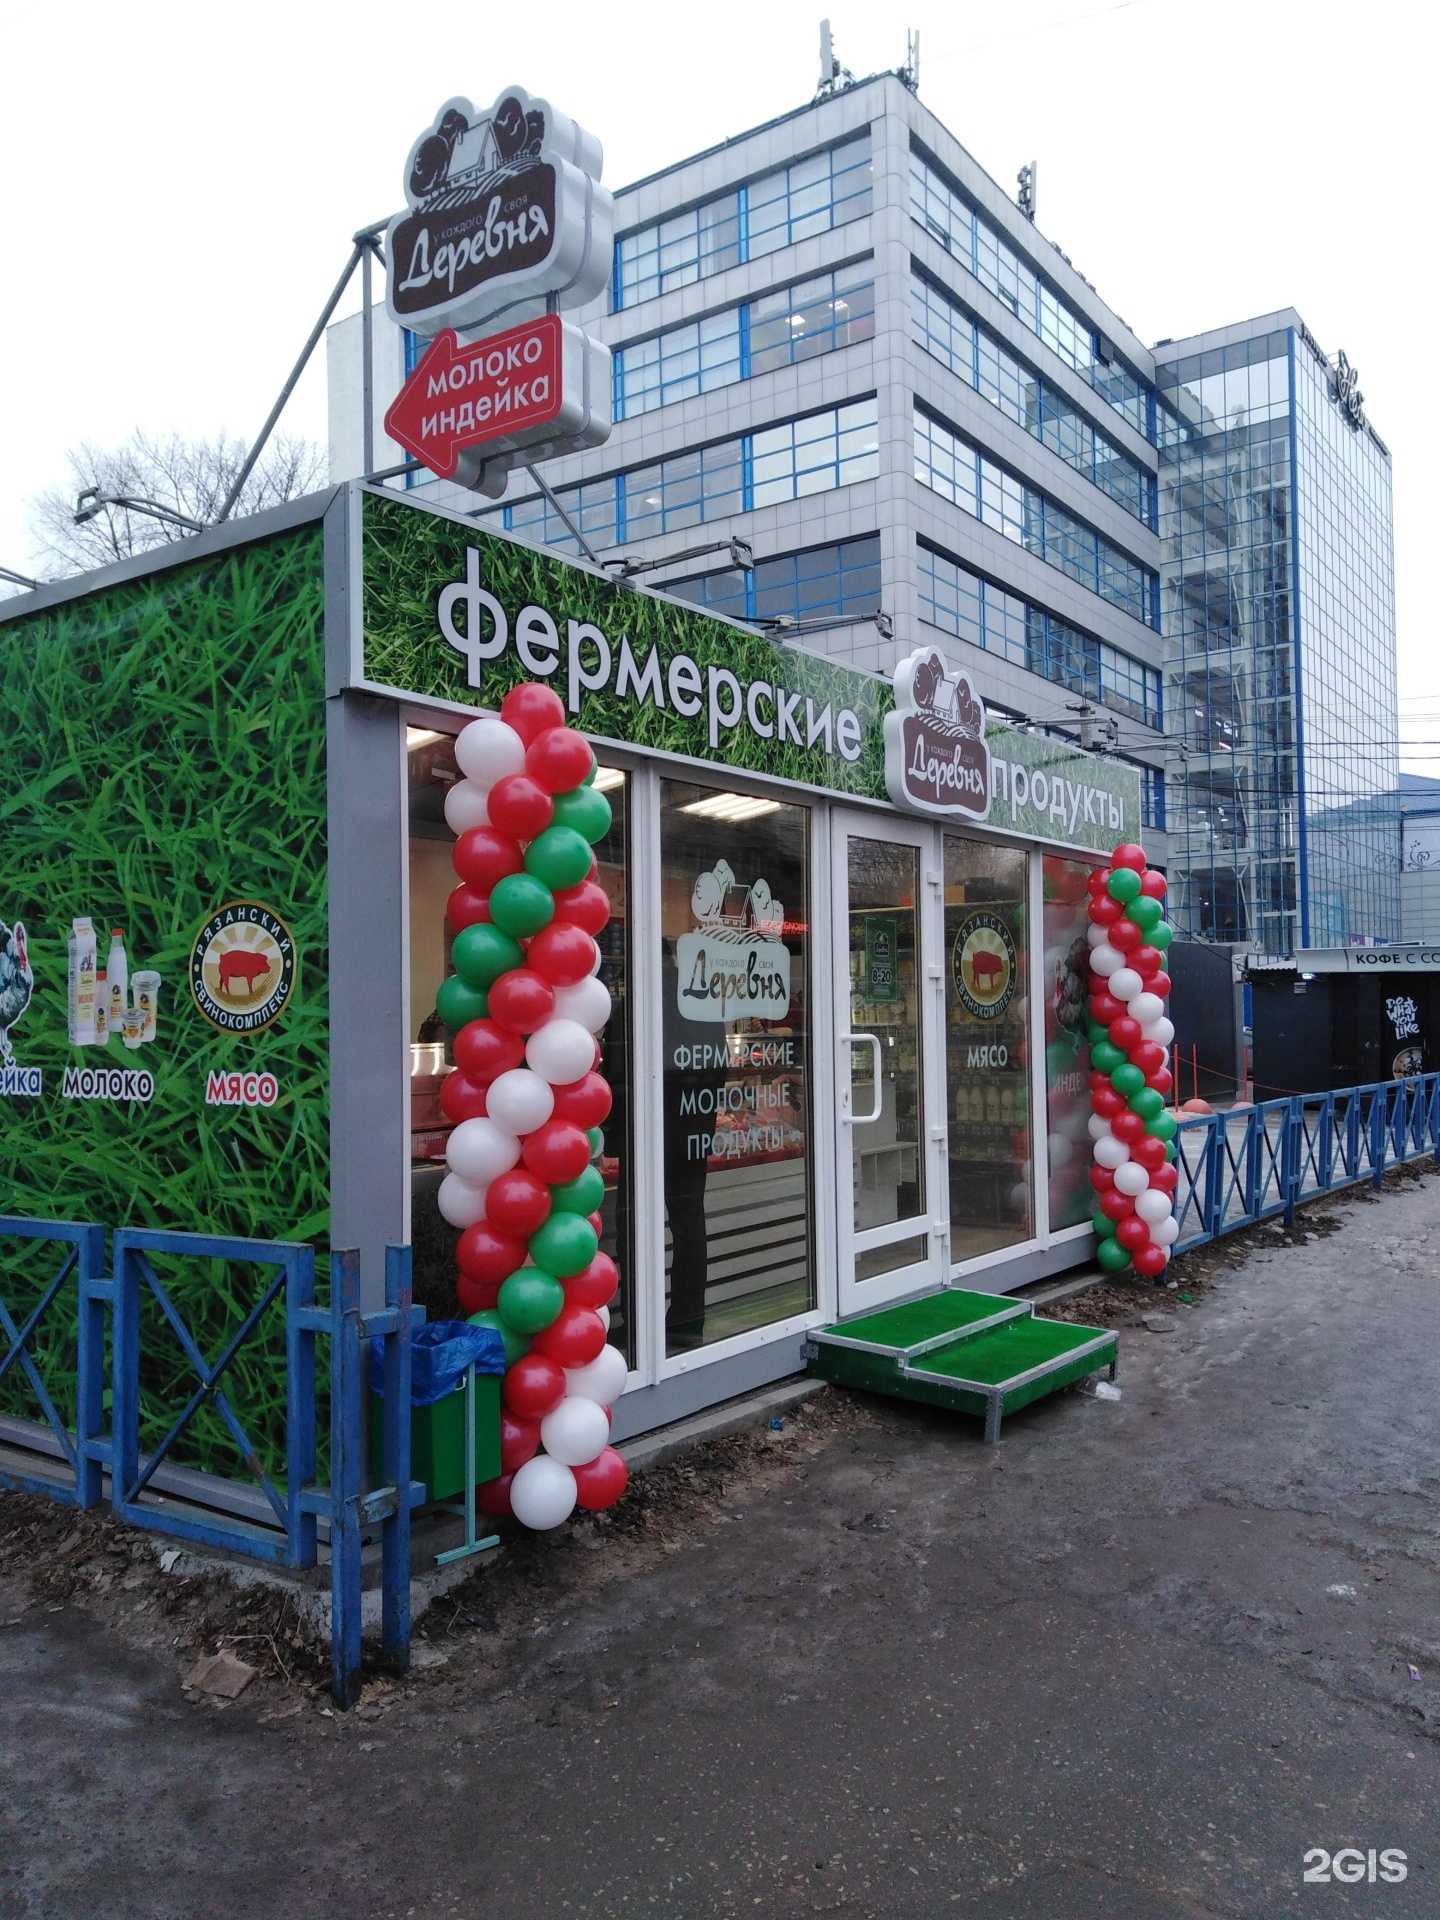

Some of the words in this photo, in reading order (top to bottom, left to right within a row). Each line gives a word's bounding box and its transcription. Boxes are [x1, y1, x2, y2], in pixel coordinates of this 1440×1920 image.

[398, 195, 549, 293] Деревня
[908, 734, 985, 799] Деревня
[197, 907, 290, 956] РЯЗАНСКИЙ
[1356, 953, 1401, 964] КОФЕ
[194, 980, 288, 1029] СВИНОКОМПЛЕКС
[682, 949, 786, 1018] Деревня
[967, 1045, 1008, 1069] МЯСО
[680, 1083, 791, 1116] МОЛОЧНЫЕ
[687, 1125, 784, 1161] ПРОДУКТЫ
